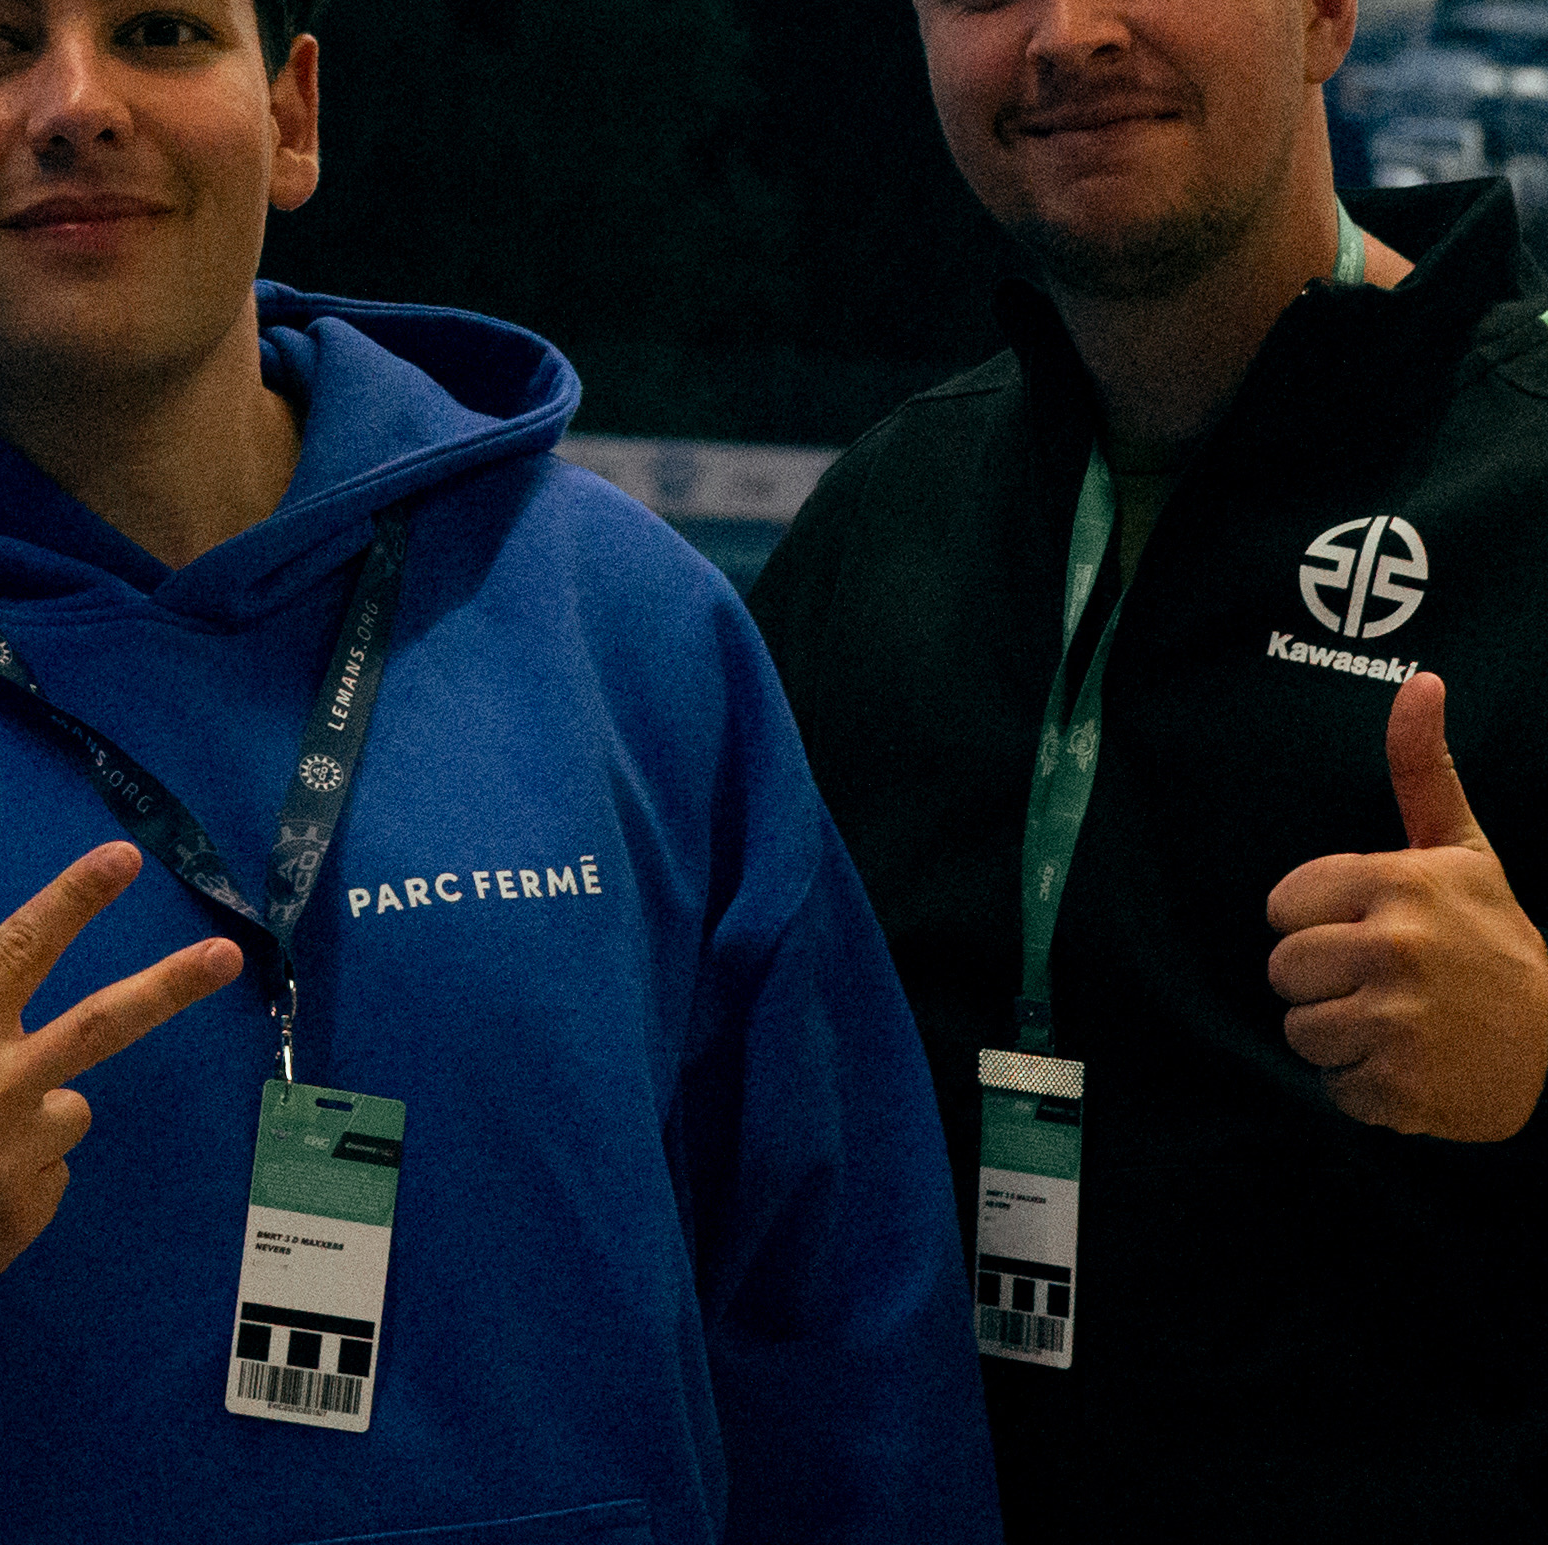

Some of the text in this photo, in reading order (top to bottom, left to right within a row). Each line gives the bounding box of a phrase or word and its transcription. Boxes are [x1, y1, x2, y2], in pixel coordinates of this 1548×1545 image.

[328, 600, 379, 732] LEMANS.ORG
[1266, 630, 1419, 684] Kawasaki
[347, 872, 463, 918] PARC
